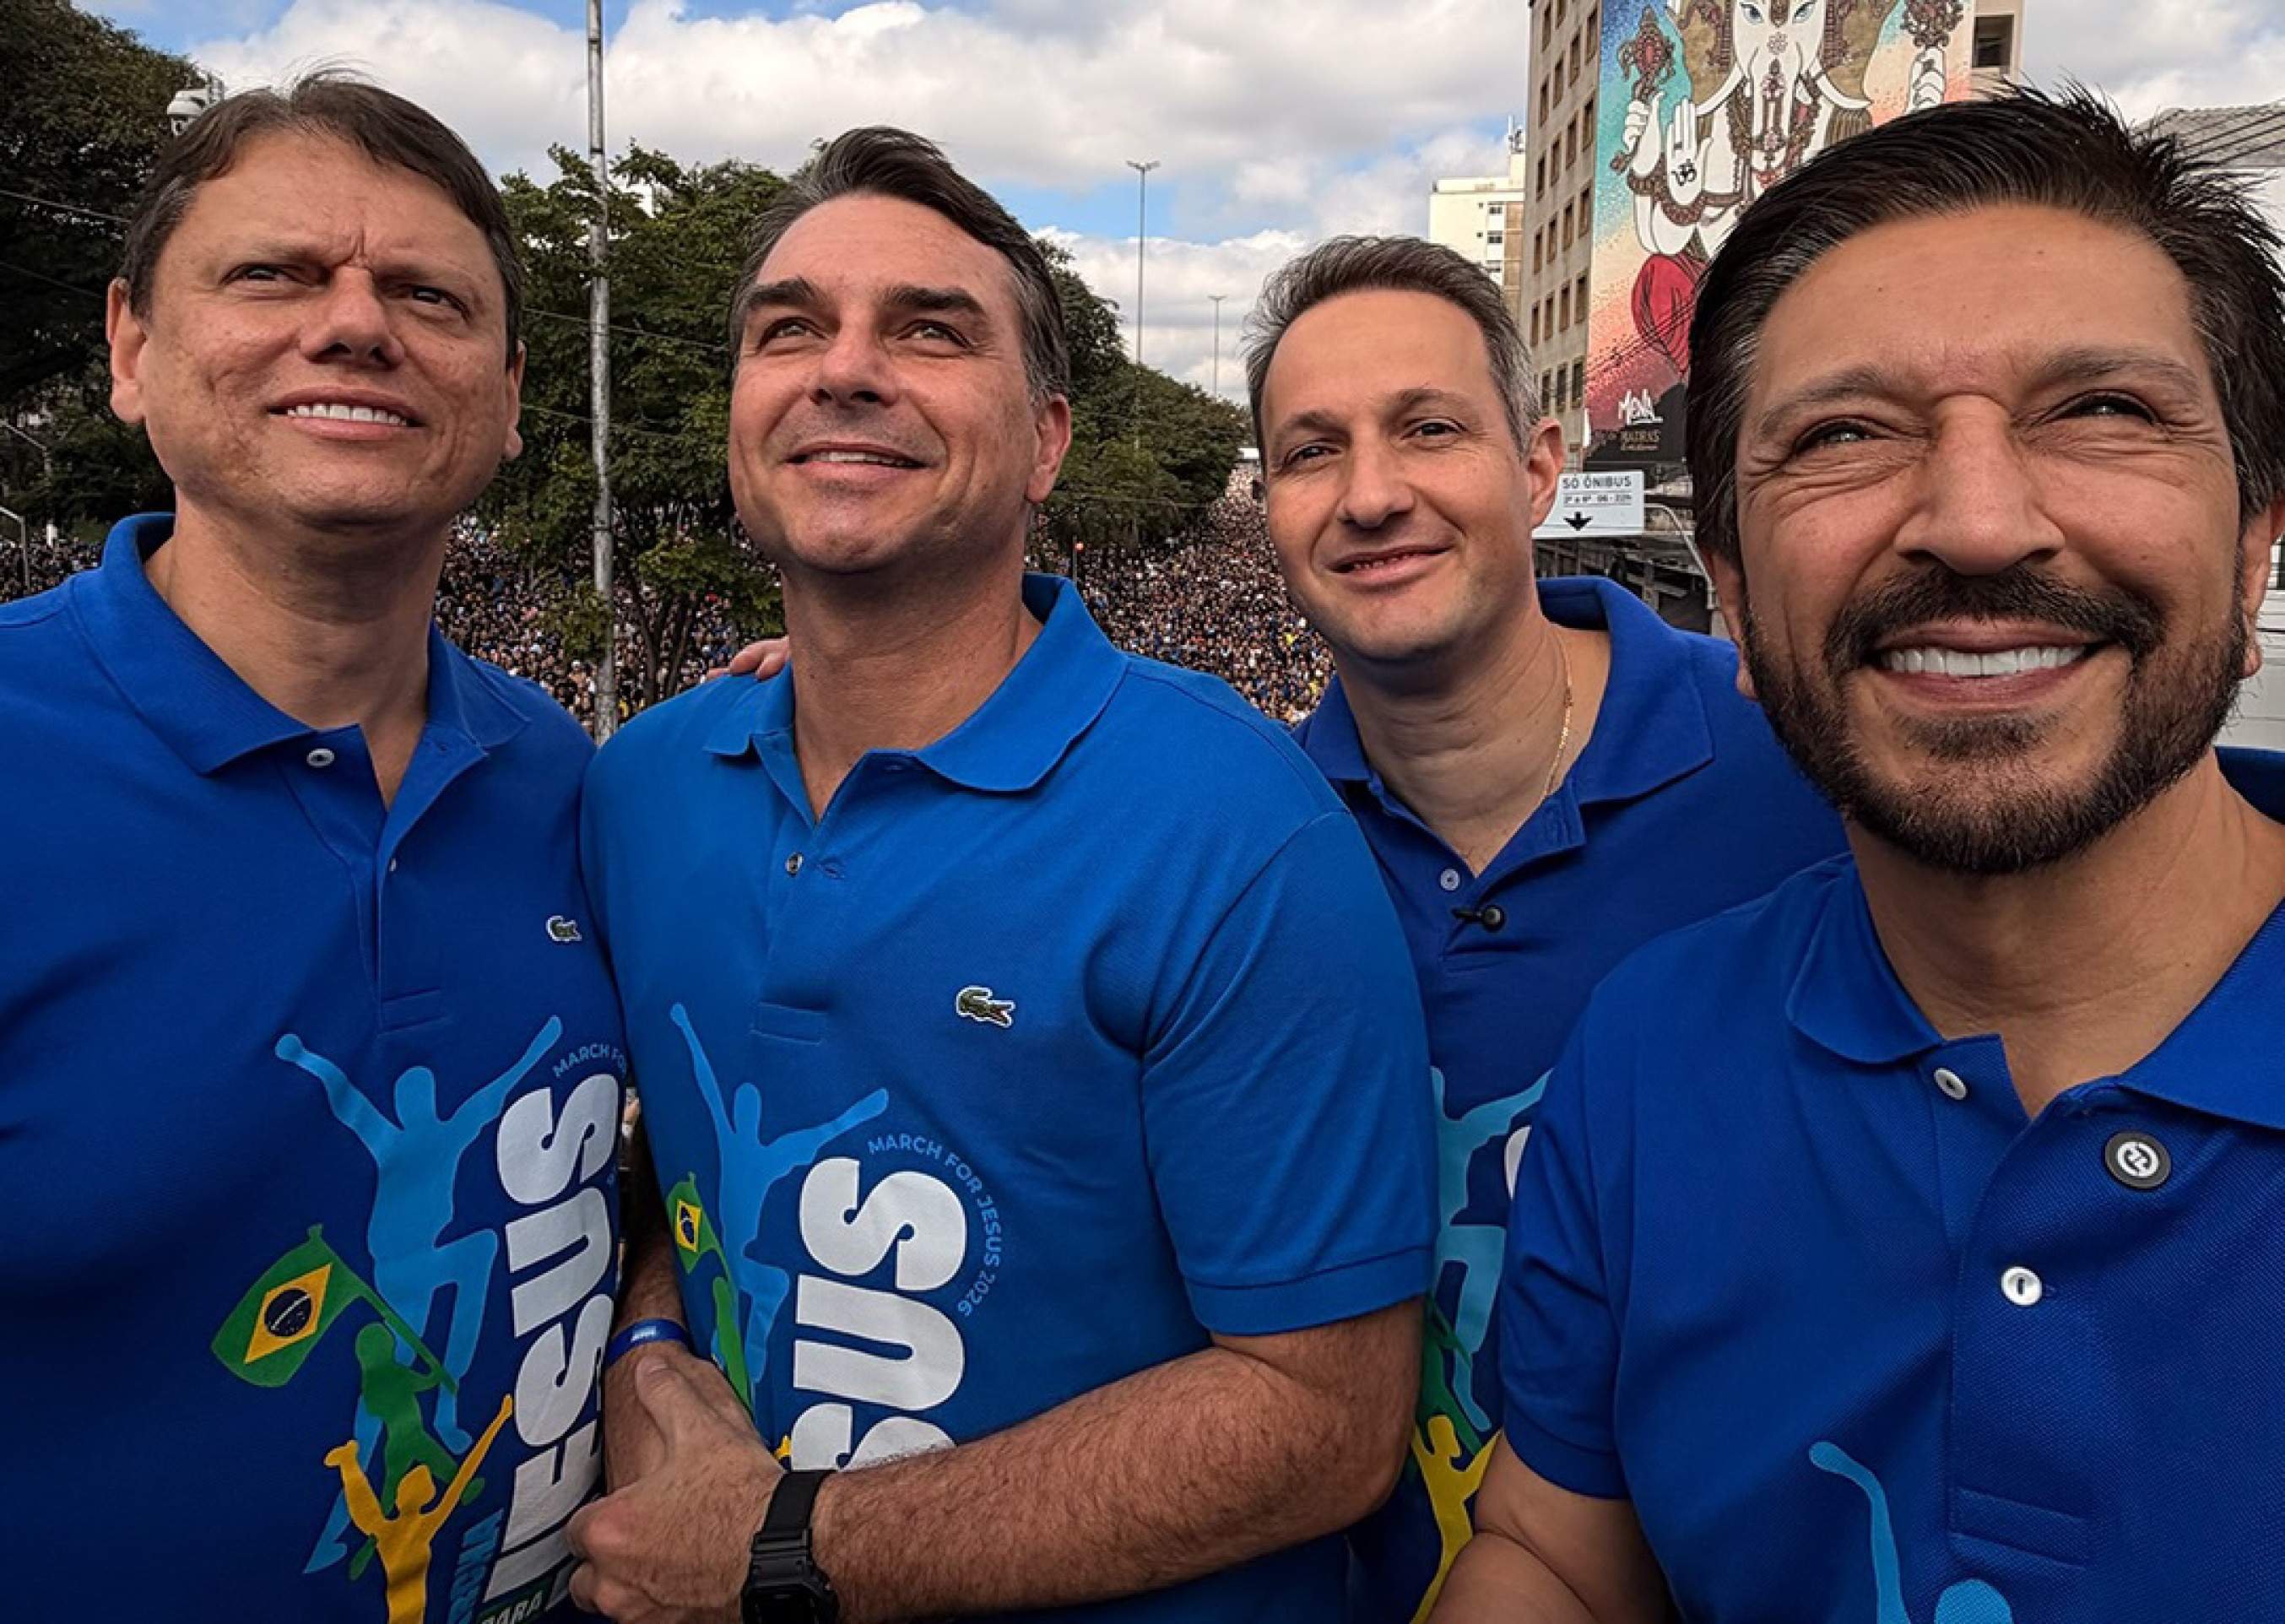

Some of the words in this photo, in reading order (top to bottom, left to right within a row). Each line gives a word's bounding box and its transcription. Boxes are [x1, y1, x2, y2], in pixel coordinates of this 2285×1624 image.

[553, 1044, 610, 1078] MARCH
[868, 1133, 943, 1160] MARCH
[953, 1152, 983, 1194] FOR
[977, 1194, 1003, 1267] JESUS
[958, 1269, 996, 1317] 2026
[484, 1075, 619, 1610] JESUS
